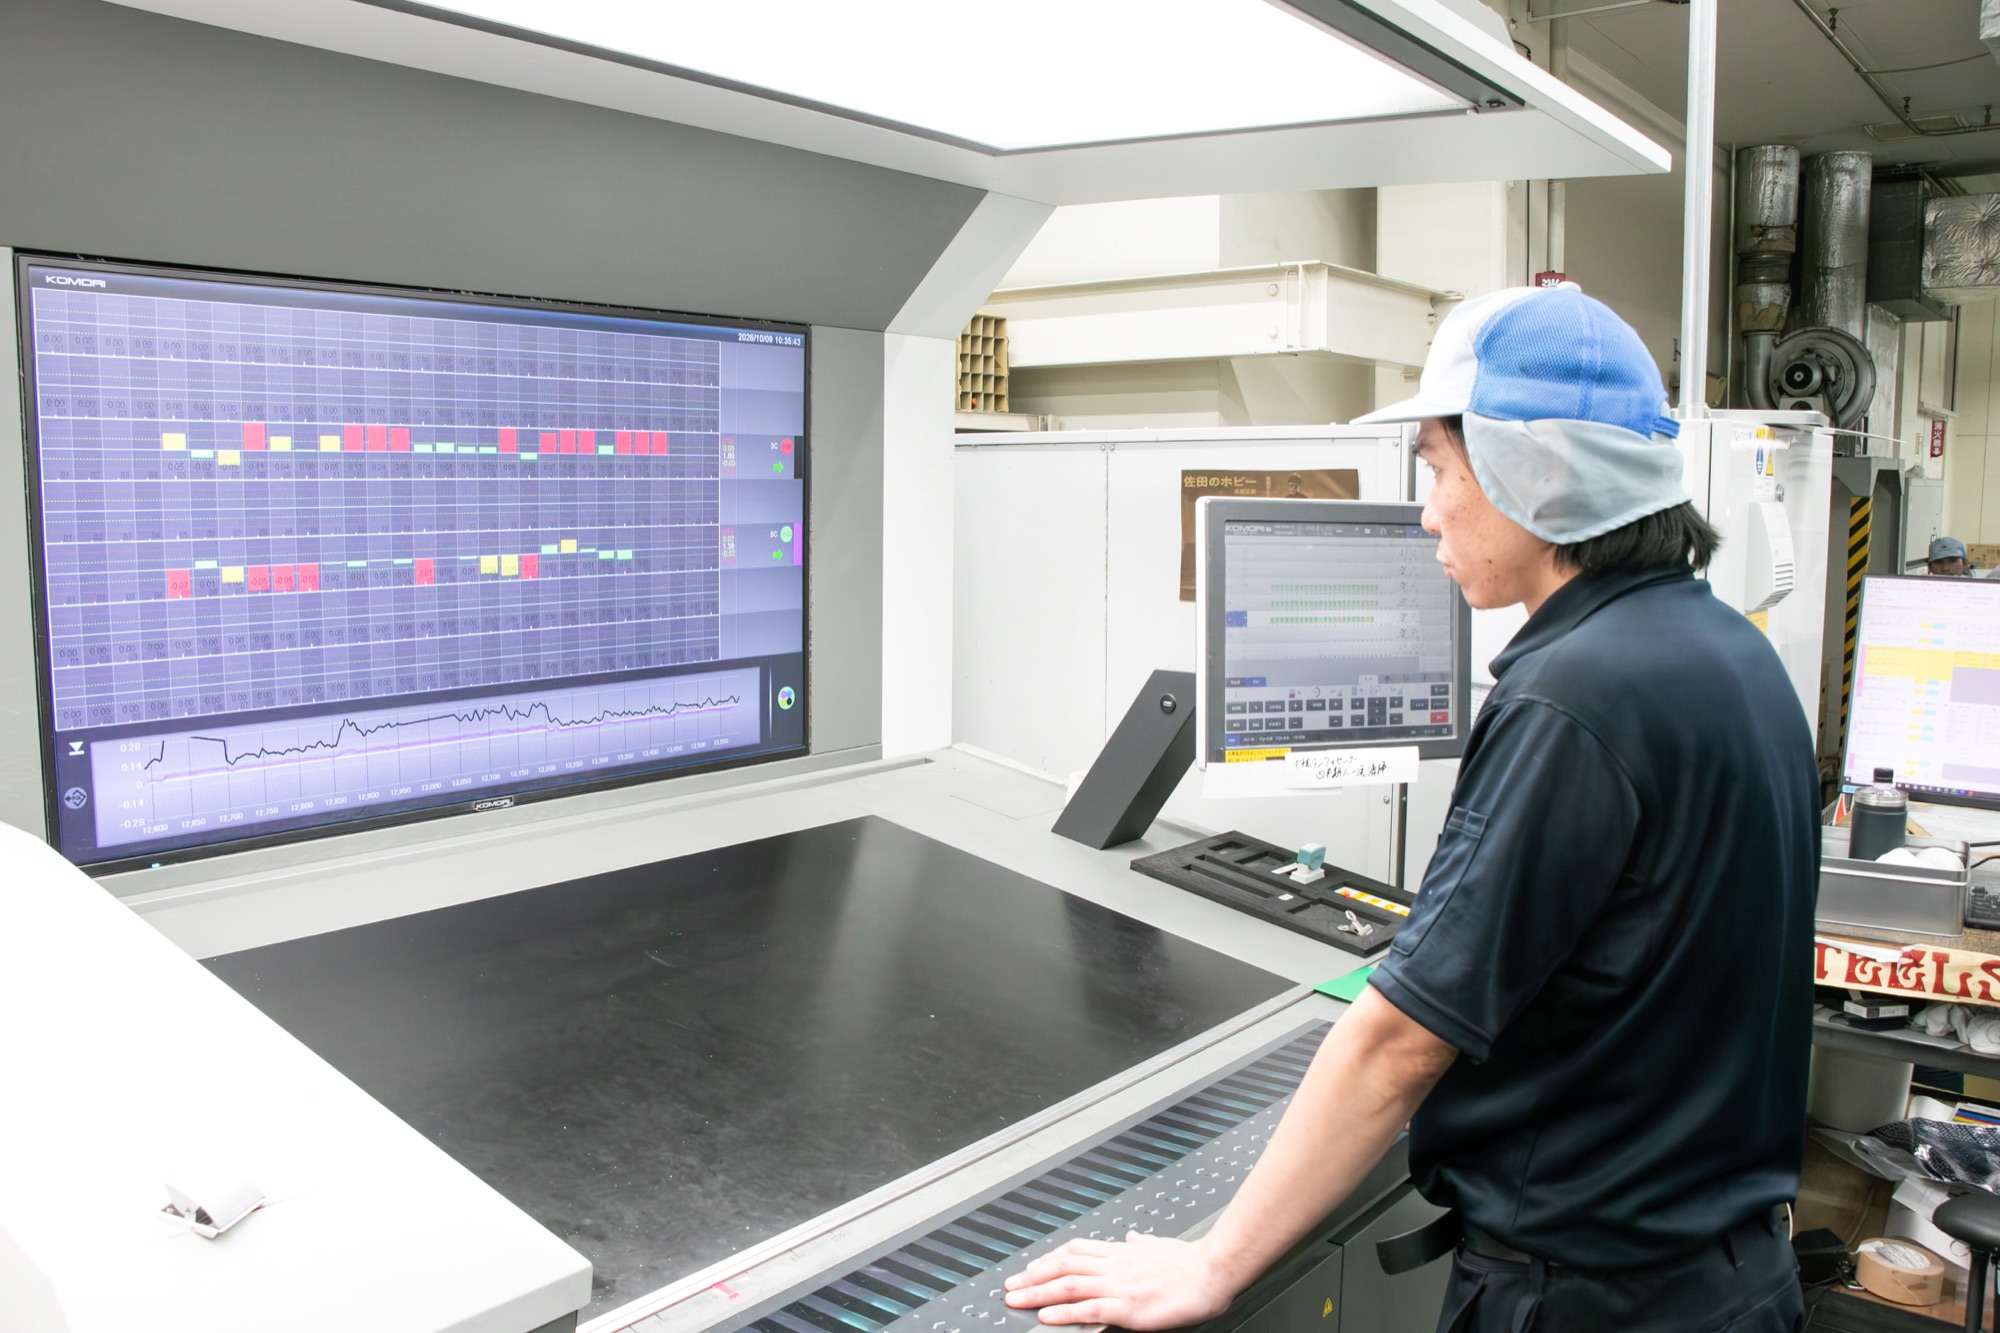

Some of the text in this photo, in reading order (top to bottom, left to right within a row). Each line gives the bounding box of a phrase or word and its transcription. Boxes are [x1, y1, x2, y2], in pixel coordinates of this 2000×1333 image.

[45, 275, 106, 288] KOMORI
[1184, 475, 1257, 487] 佐田のホビー
[120, 743, 141, 752] 0.28
[121, 762, 142, 772] 0.14
[219, 812, 243, 822] 12,700
[255, 807, 278, 817] 12,750
